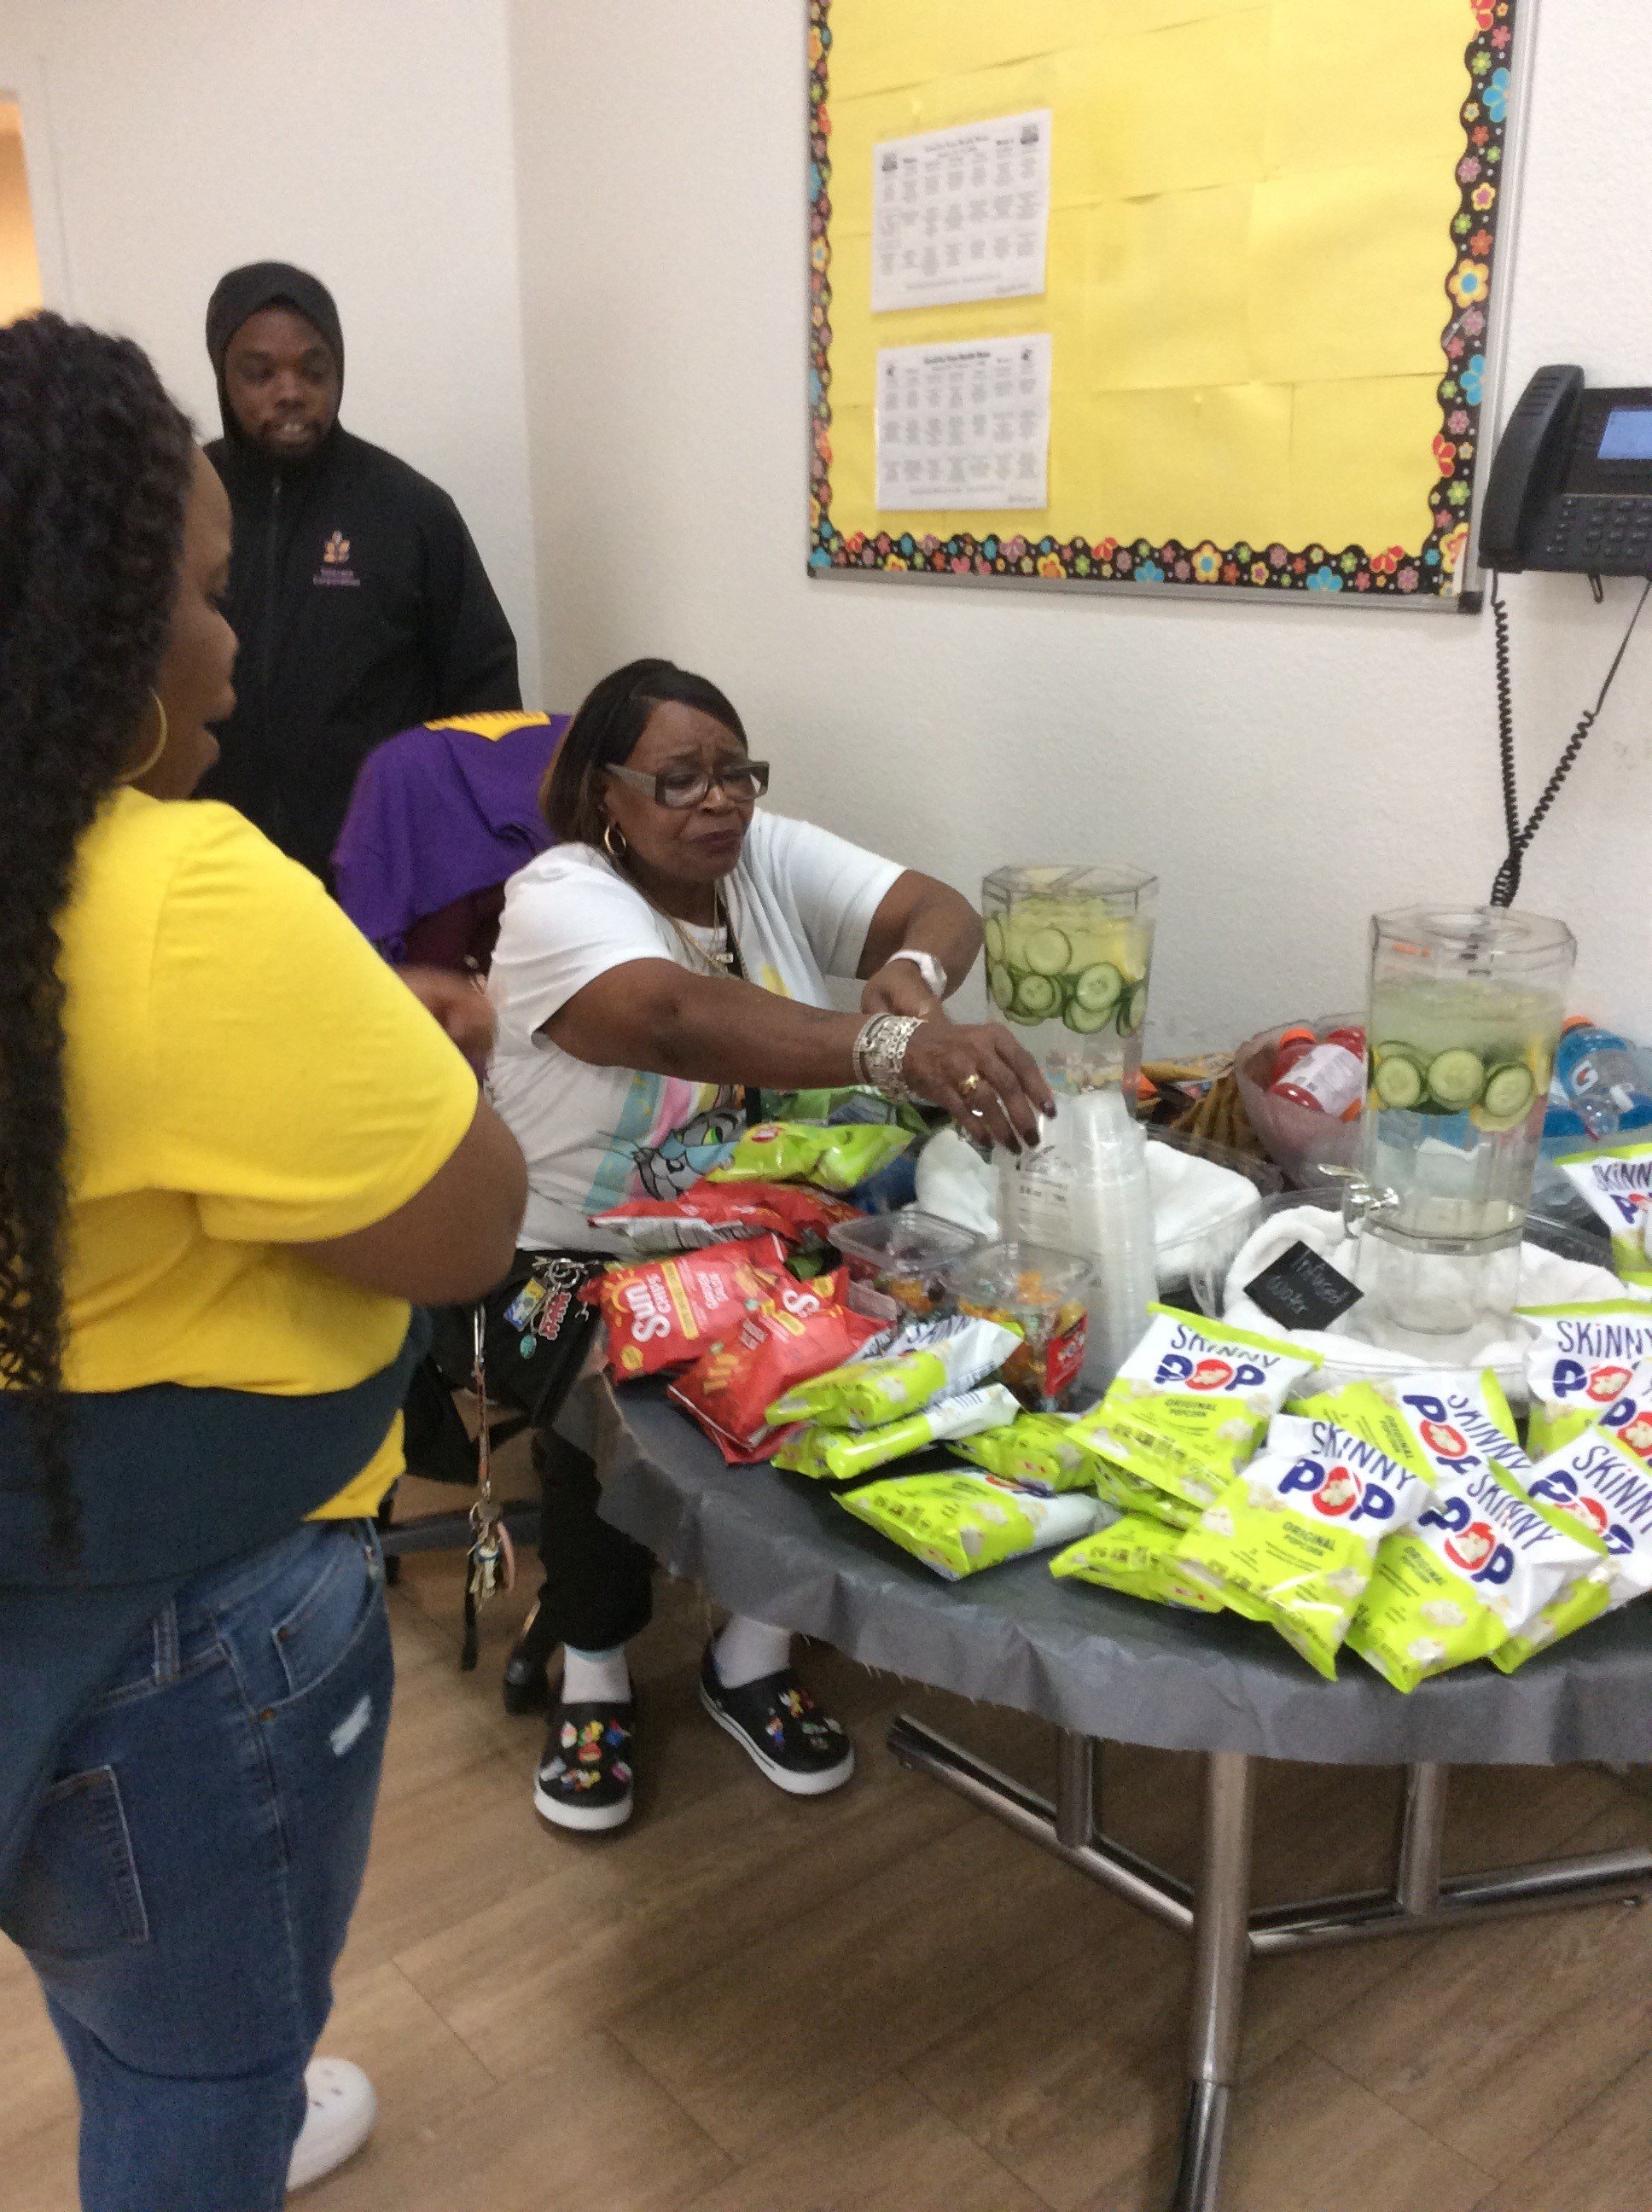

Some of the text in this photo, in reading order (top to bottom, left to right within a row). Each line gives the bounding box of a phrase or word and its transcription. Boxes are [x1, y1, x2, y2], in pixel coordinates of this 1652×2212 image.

[1154, 1353, 1266, 1392] POP
[1552, 1359, 1634, 1403] PO
[1312, 1421, 1418, 1492] SKINNY
[1277, 1458, 1396, 1522] POP
[1416, 1496, 1515, 1585] POP
